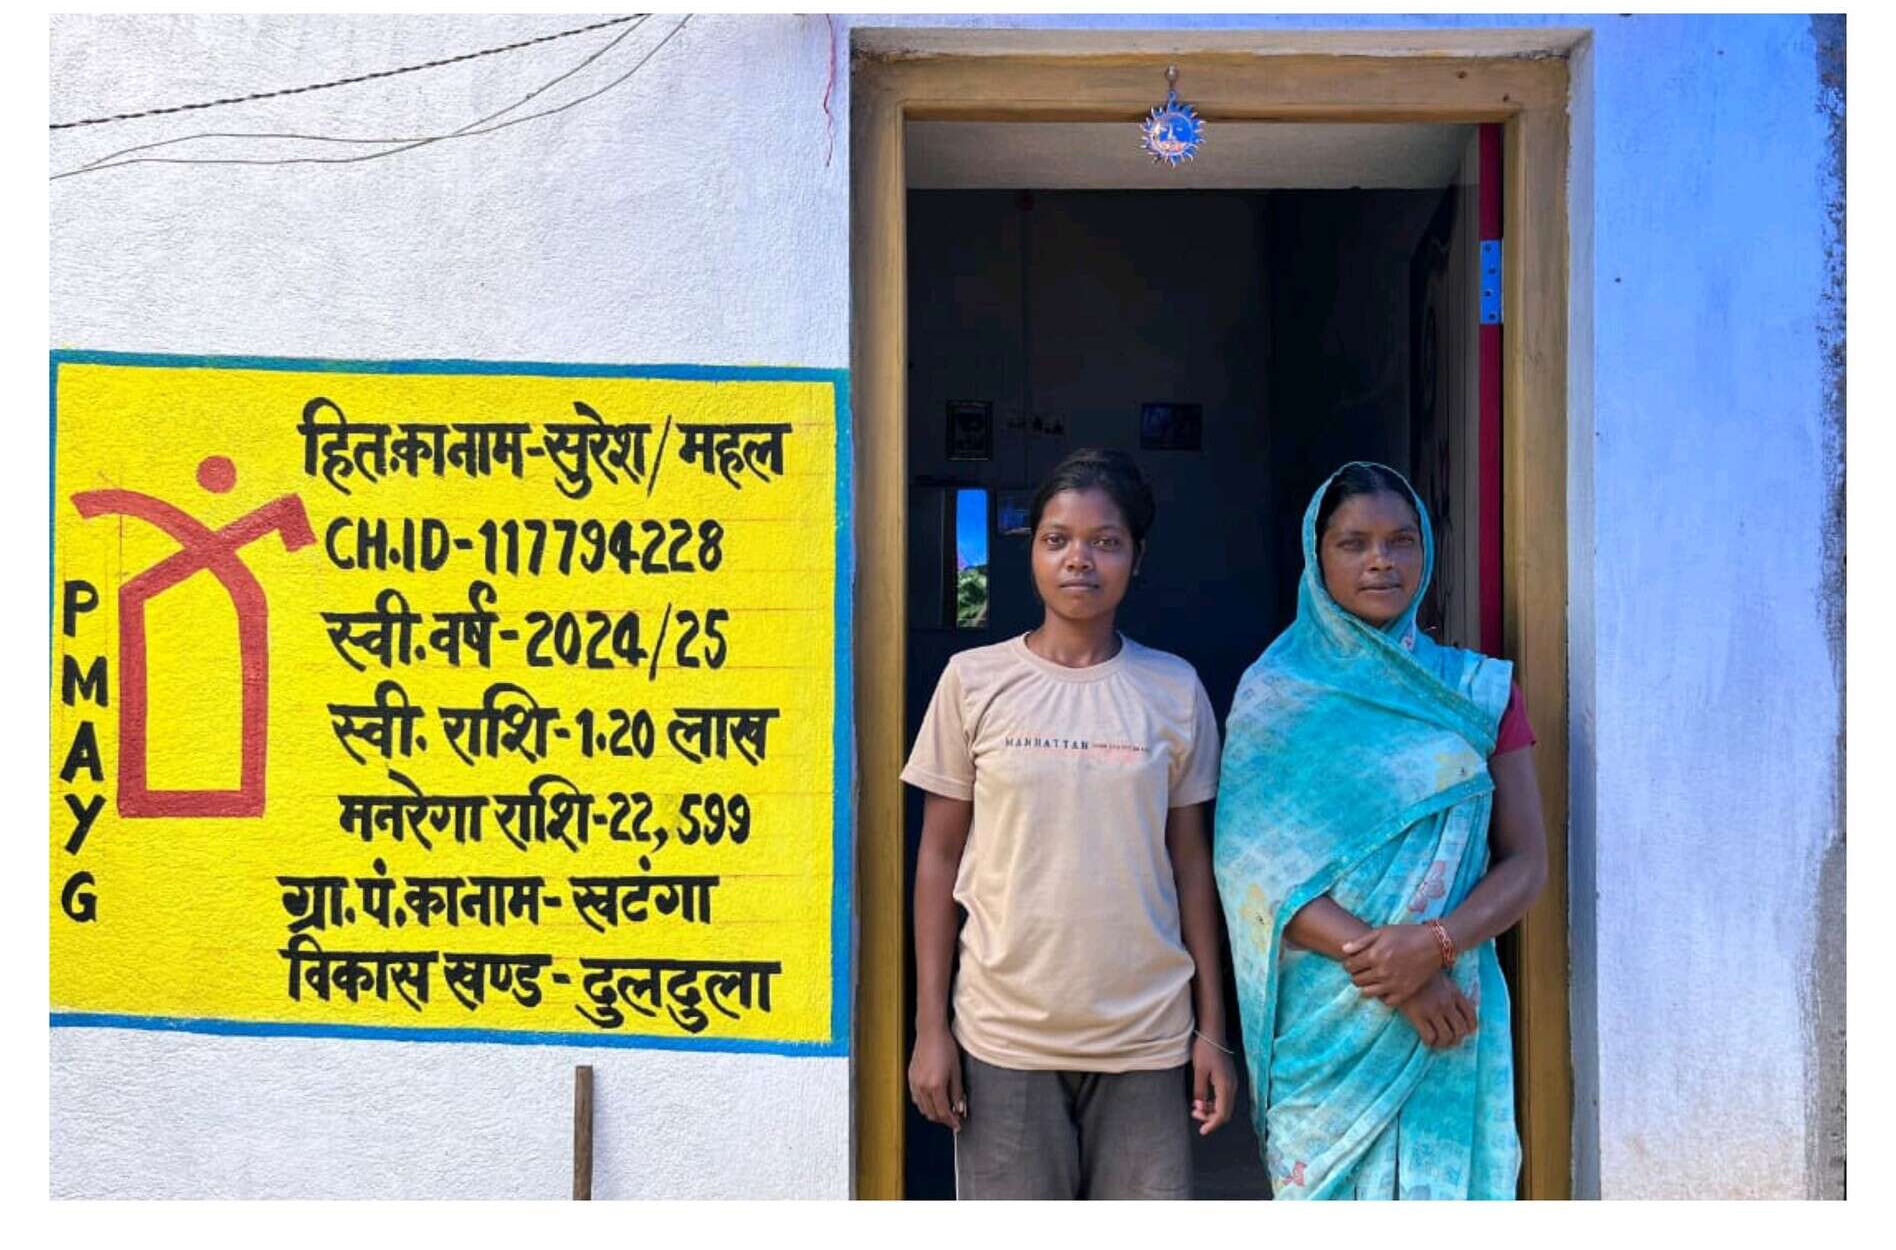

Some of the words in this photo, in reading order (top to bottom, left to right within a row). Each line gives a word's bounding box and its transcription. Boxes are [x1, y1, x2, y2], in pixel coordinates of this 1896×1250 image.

[666, 707, 781, 767] लाख
[336, 766, 491, 851] मनरेगा
[277, 932, 440, 1013] विकास
